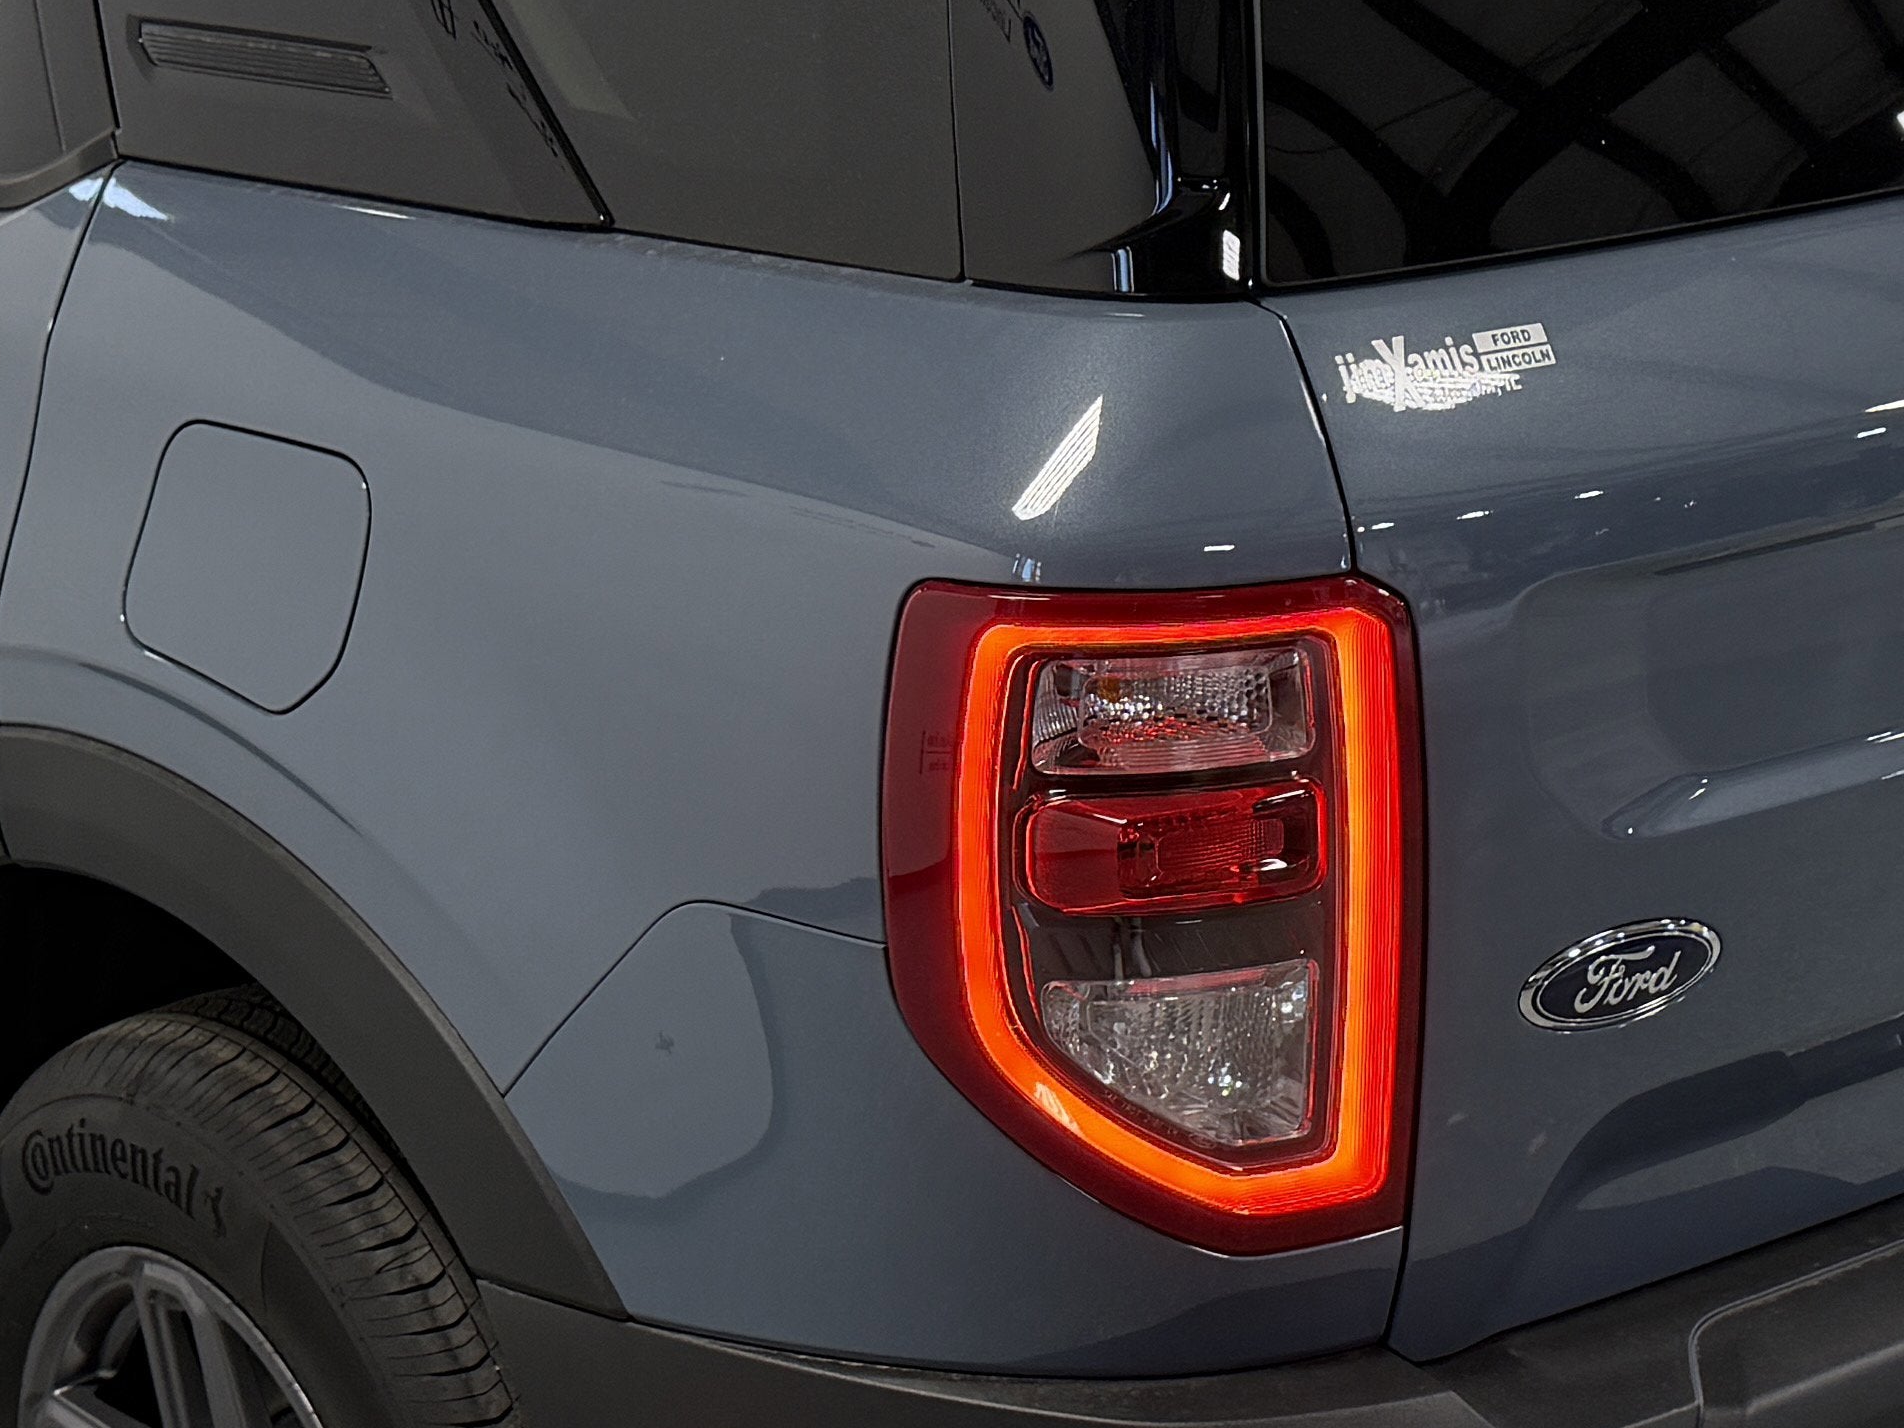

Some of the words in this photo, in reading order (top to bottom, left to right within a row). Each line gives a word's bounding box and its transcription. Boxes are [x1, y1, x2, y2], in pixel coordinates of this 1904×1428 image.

[1486, 349, 1552, 373] LINCOLN
[1490, 328, 1532, 347] FORD
[1573, 944, 1683, 1014] Ford
[20, 1116, 201, 1221] Continental
